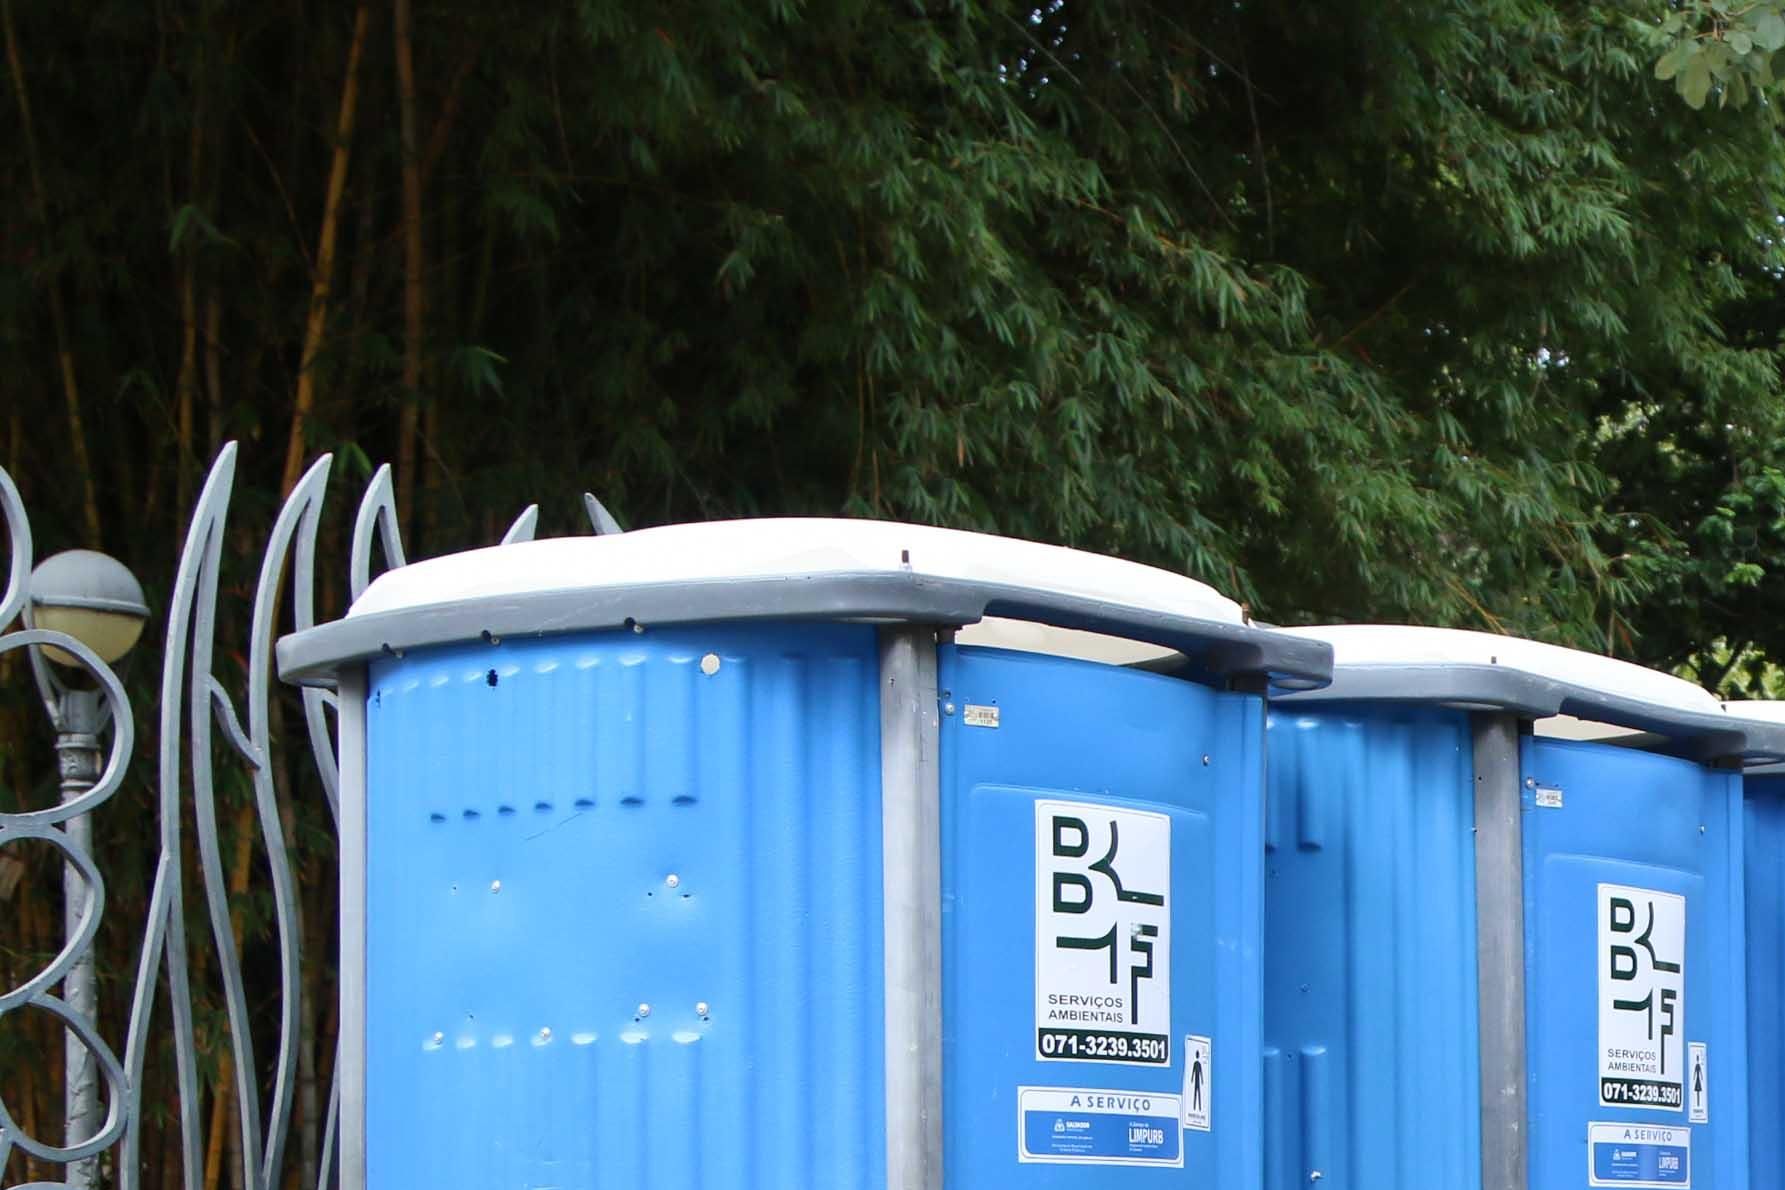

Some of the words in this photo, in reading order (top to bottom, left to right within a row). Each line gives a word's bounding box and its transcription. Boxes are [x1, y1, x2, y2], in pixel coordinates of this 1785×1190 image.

[1048, 994, 1124, 1009] SERVIÇOS
[1048, 1009, 1124, 1024] AMBIENTAIS
[1041, 1034, 1166, 1060] 071-3239.3501
[1607, 1048, 1657, 1062] SERVIÇOS
[1607, 1062, 1657, 1073] AMBIENTAIS
[1603, 1082, 1681, 1105] 071-3239.3501
[1070, 1095, 1081, 1107] A
[1087, 1096, 1151, 1112] SERVIÇO
[1128, 1127, 1165, 1145] LIMPURB
[1623, 1129, 1631, 1139] A
[1634, 1129, 1673, 1142] SERVIÇO
